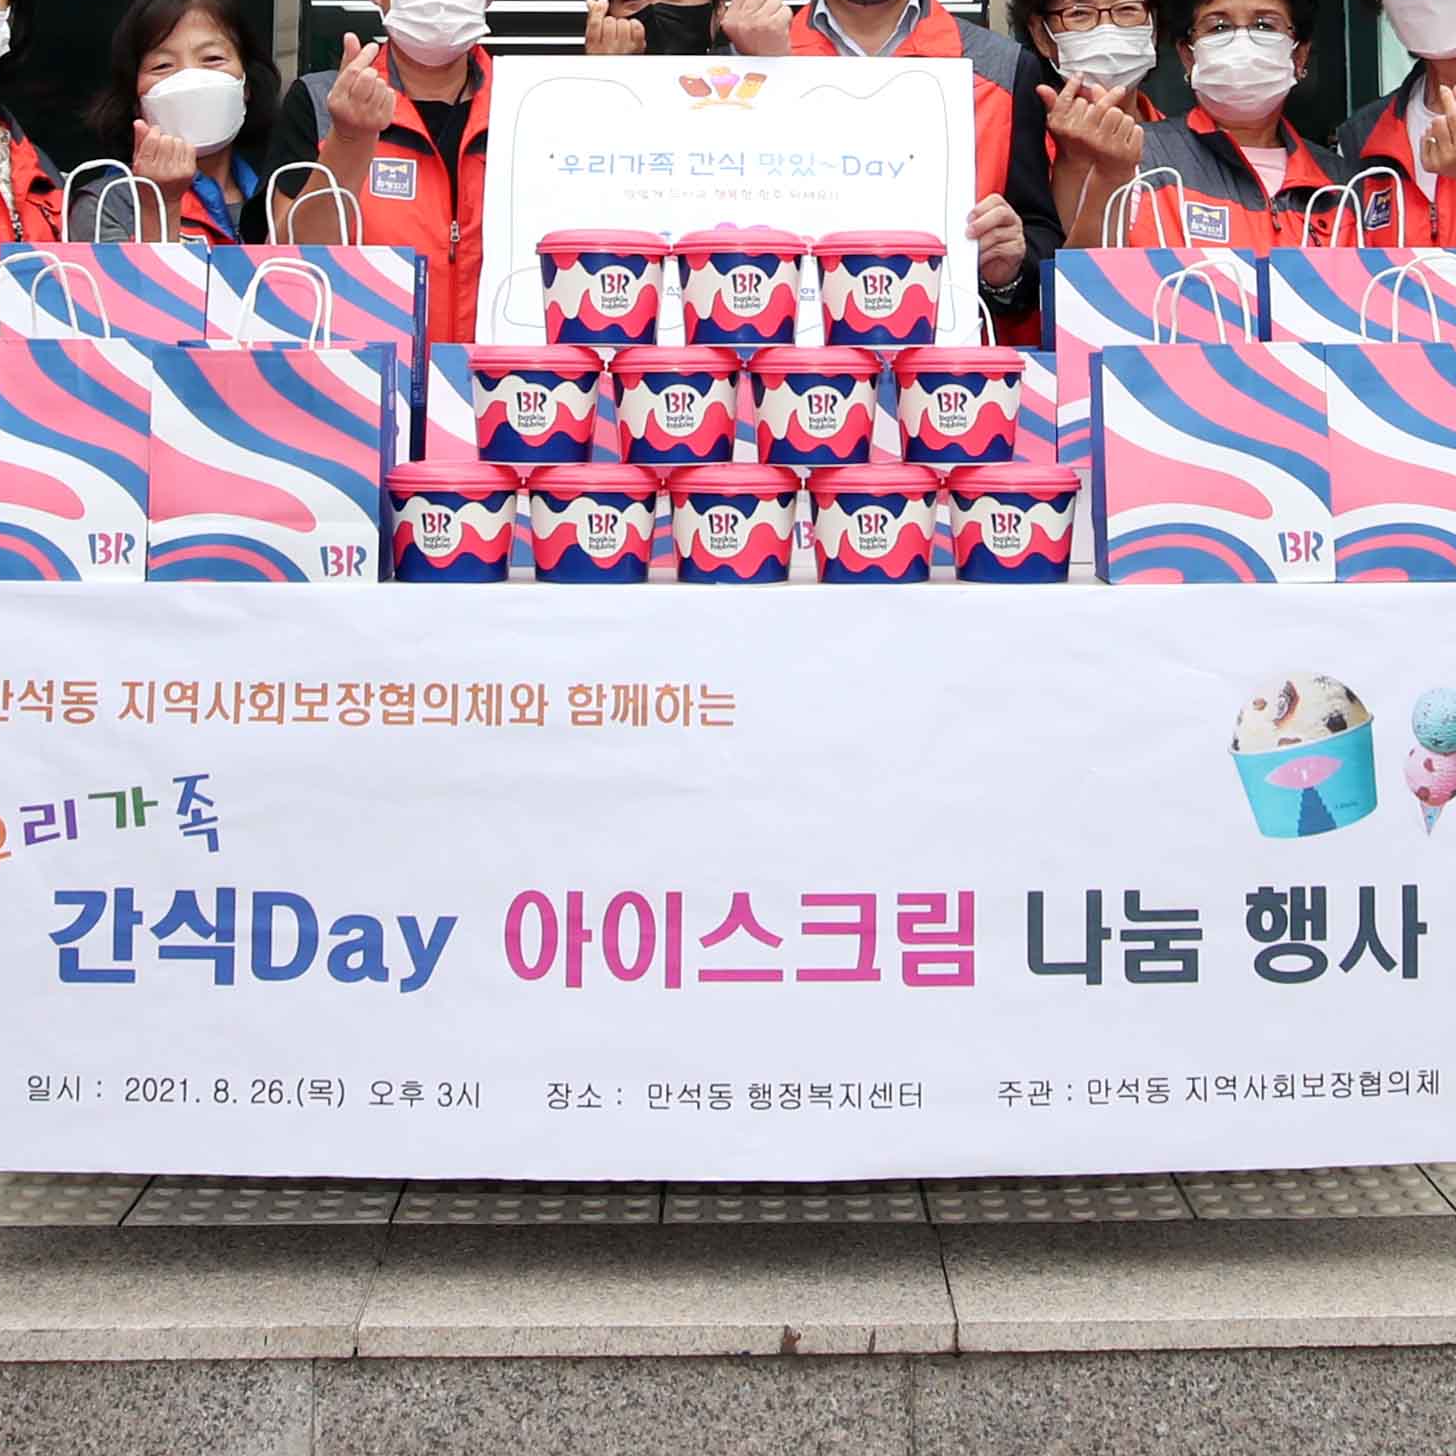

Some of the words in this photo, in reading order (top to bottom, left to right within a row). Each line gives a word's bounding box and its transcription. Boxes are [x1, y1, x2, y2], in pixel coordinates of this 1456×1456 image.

[687, 151, 744, 177] 간식
[601, 273, 630, 294] BR
[732, 273, 762, 294] BR
[863, 274, 893, 295] BR
[516, 391, 547, 413] BR
[665, 392, 695, 413] BR
[808, 393, 838, 414] BR
[937, 392, 967, 413] BR
[422, 512, 451, 534] BR
[588, 513, 618, 534] BR
[708, 513, 739, 534] BR
[857, 513, 888, 534] BR
[991, 513, 1021, 534] BR
[88, 532, 135, 565] BR
[1278, 531, 1324, 563] BR
[320, 544, 368, 577] BR
[118, 680, 549, 727] 지역사회보장협의체와
[567, 683, 736, 728] 함께하는
[48, 887, 459, 994] 간식Day
[504, 889, 976, 990] 아이스크림
[1027, 889, 1204, 986] 나눔
[1244, 884, 1428, 985] 행사
[26, 1074, 82, 1104] 일시
[124, 1077, 201, 1104] 2021.
[212, 1078, 238, 1105] 8.
[250, 1076, 346, 1109] 26.(목)
[367, 1079, 425, 1109] 오후
[436, 1081, 481, 1109] 3시
[546, 1081, 603, 1111] 장소
[647, 1081, 734, 1111] 만석동
[747, 1081, 923, 1111] 행정복지센터
[997, 1078, 1053, 1107] 주관
[1086, 1074, 1171, 1105] 만석동
[1184, 1068, 1441, 1103] 지역사회보장협의체
